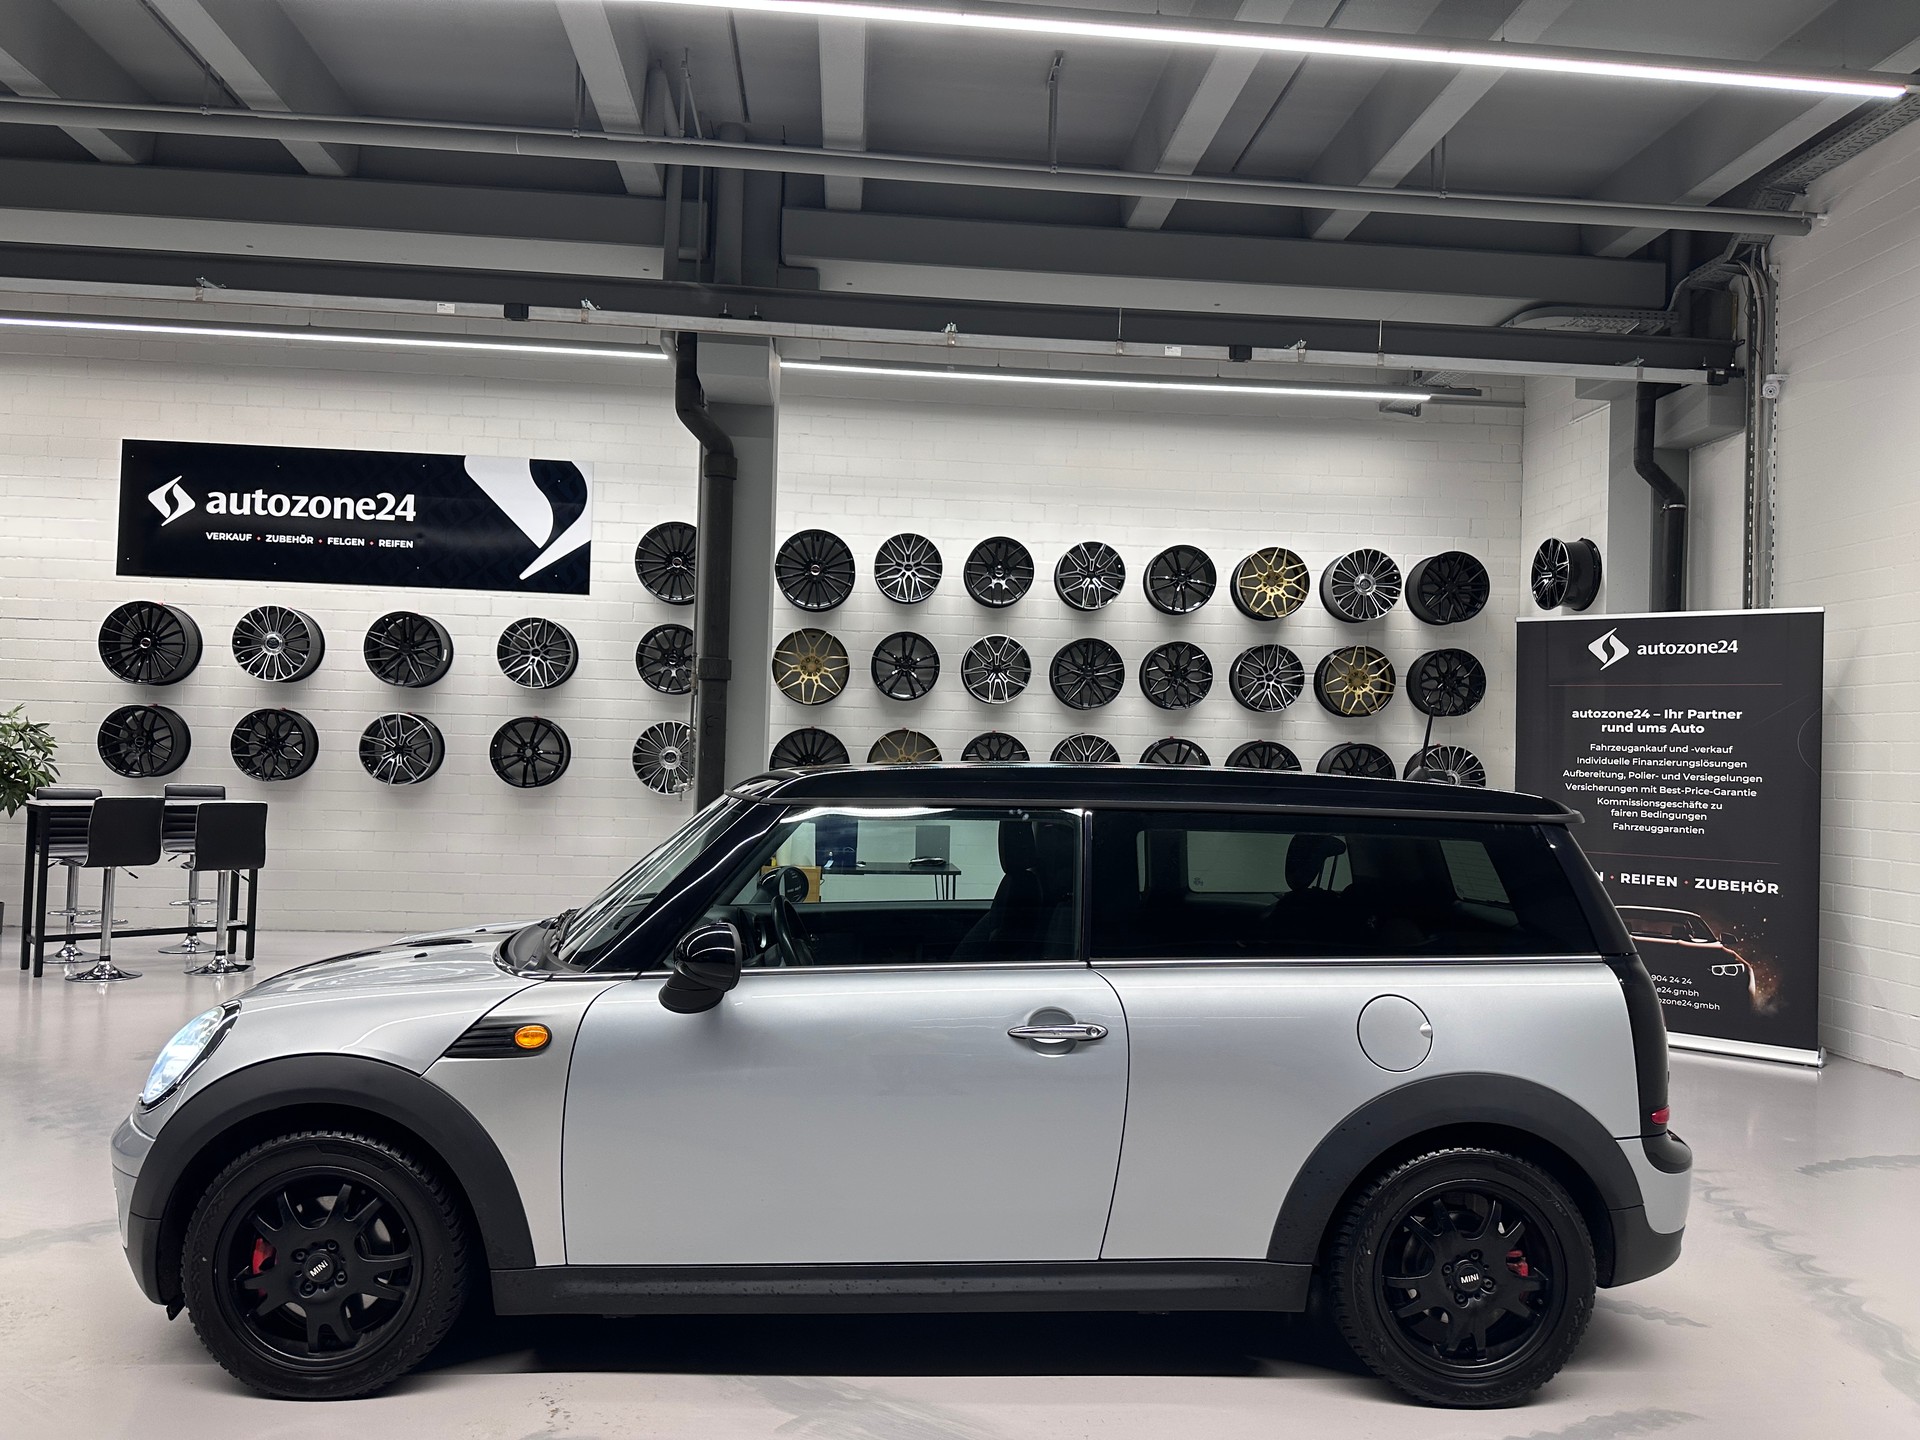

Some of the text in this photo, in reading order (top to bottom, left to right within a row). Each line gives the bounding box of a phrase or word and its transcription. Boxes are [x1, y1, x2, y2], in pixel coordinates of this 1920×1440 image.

[205, 488, 417, 522] autozone24
[205, 531, 414, 549] VERKAUF ZUBEHÖR FELGEN REIFEN
[1636, 639, 1739, 656] autozone24
[1571, 708, 1651, 720] autozone24
[1664, 708, 1685, 720] Ihr
[1687, 708, 1743, 720] Partner
[1601, 722, 1706, 734] rund ums Auto
[1589, 743, 1734, 754] Fahrzeugankauf und -verkauf
[1576, 756, 1748, 770] Individuelle Finanzierungslösungen
[1562, 769, 1763, 785] Aufbereitung, Polier- und Versiegelungen
[1564, 782, 1758, 798] Versicherungen mit Best-Price-Garantie
[1596, 797, 1723, 811] Kommissionsgeschäfte zu
[1610, 808, 1708, 822] fairen Bedingungen
[1612, 822, 1705, 835] Fahrzeuggarantien
[1620, 872, 1678, 888] REIFEN
[1694, 878, 1779, 895] ZUBEHÖR
[1651, 974, 1693, 985] 904 24 24
[1656, 986, 1700, 997] e24.gmbh
[1658, 998, 1721, 1011] ozone24.gmbh
[309, 1259, 329, 1277] MINI
[1460, 1273, 1479, 1284] MINI
